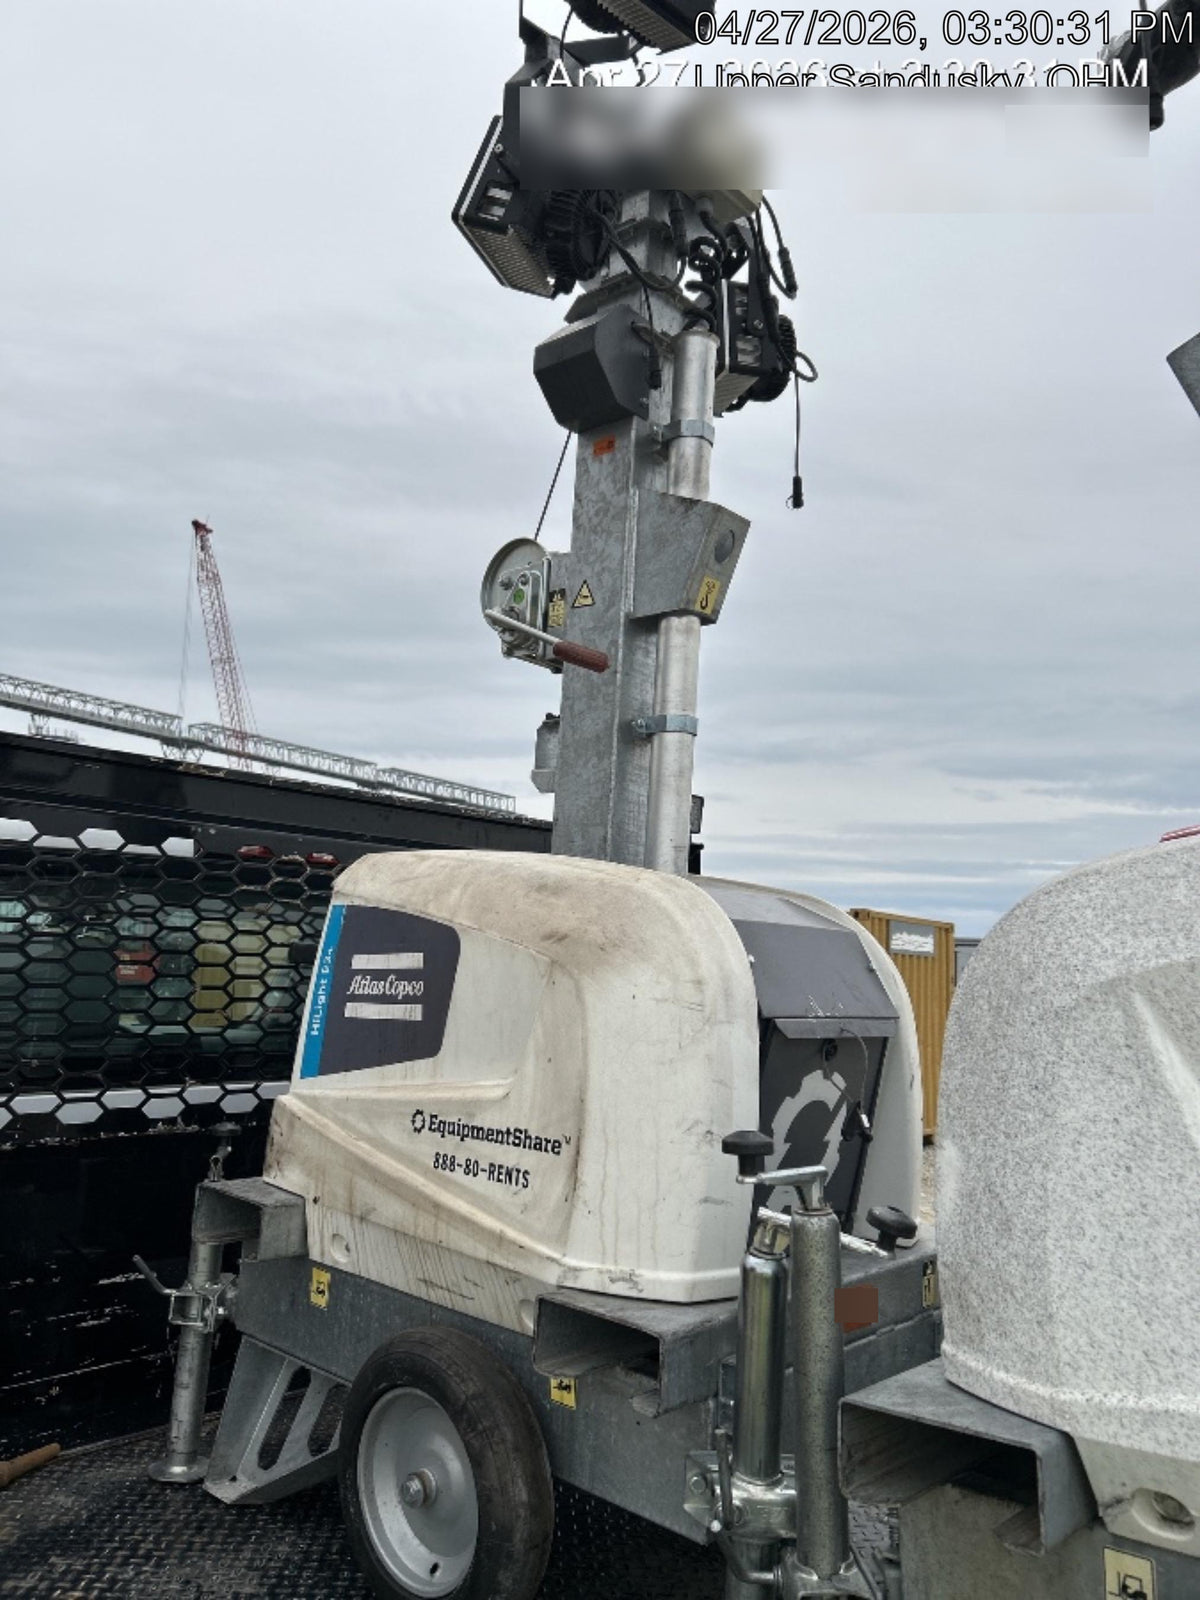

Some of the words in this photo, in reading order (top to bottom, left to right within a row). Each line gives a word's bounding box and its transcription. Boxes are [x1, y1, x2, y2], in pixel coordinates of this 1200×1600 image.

[346, 974, 384, 996] Atlas
[385, 973, 424, 1000] Copco
[433, 1152, 531, 1188] 888-80-RENTS
